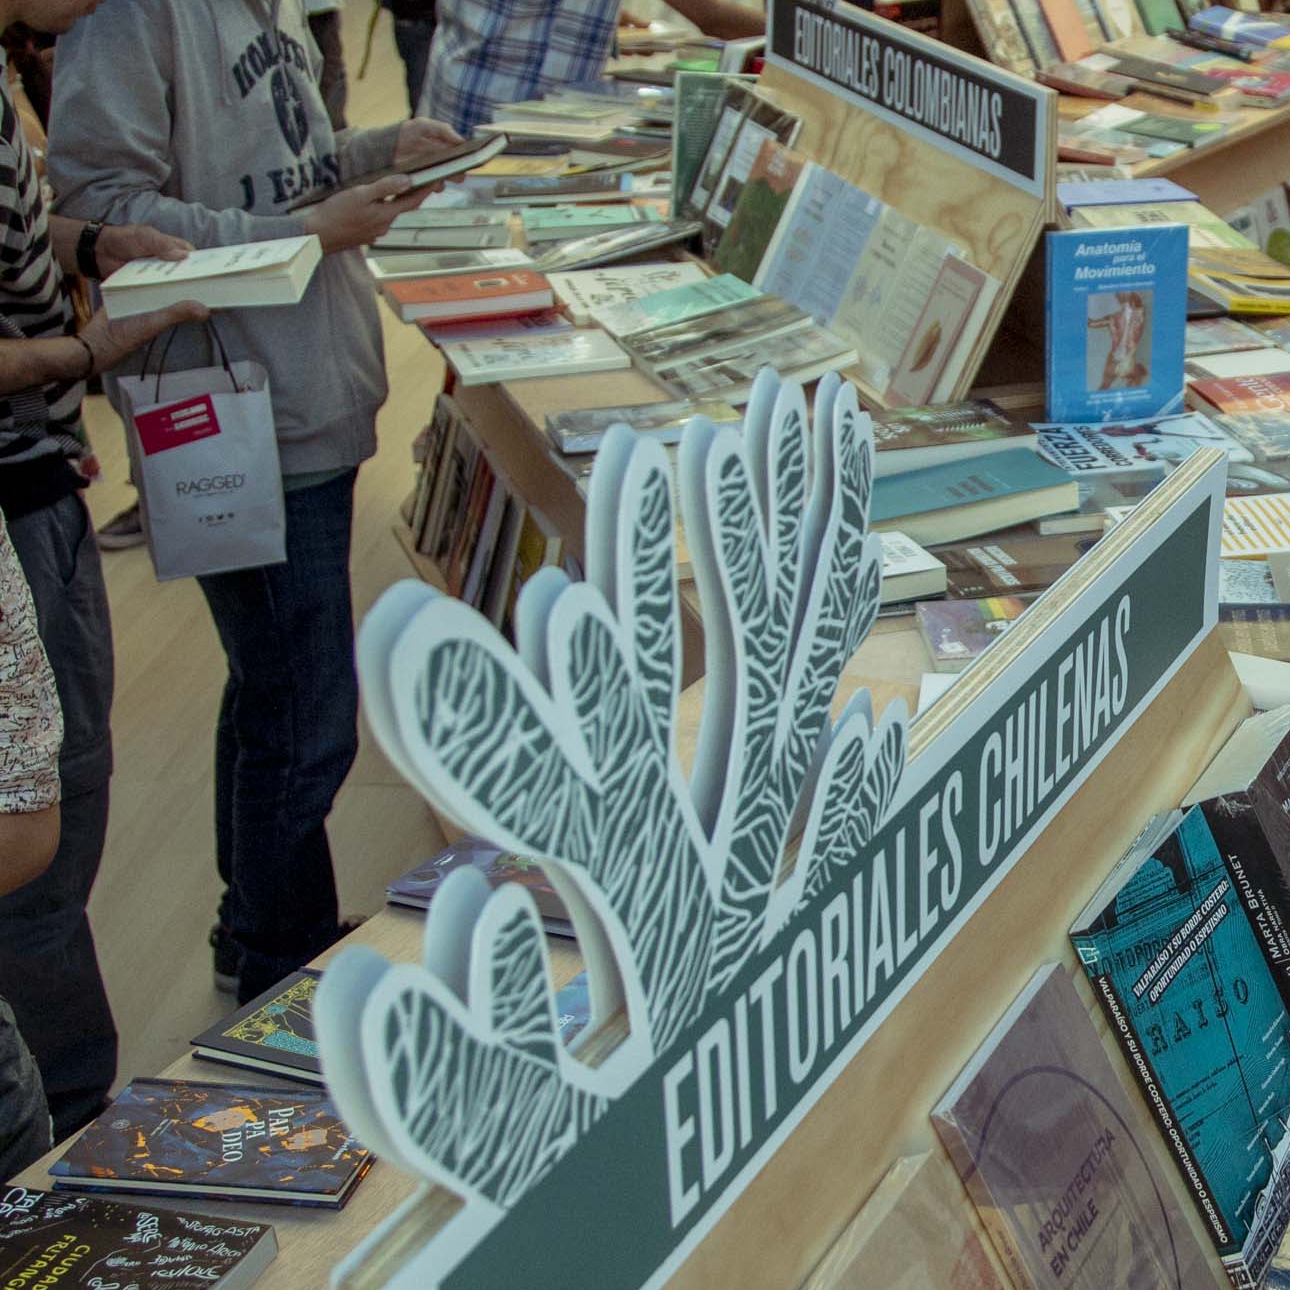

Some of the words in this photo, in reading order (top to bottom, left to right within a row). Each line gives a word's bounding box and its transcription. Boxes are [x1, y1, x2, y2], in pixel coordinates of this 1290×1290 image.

[794, 6, 879, 100] EDITORIALES
[883, 45, 1002, 159] COLOMBIANAS
[1073, 263, 1156, 280] Movimiento
[1043, 426, 1108, 471] FUERZA
[175, 474, 246, 496] RAGGED
[1227, 853, 1260, 910] BRUNET
[663, 780, 965, 1231] EDITORIALES
[977, 593, 1131, 867] CHILENAS
[1256, 888, 1280, 933] NARRATIVA
[1132, 952, 1167, 998] VALPARAÍSO
[1180, 910, 1203, 940] BORDE
[1200, 878, 1230, 916] COSTERO:
[1149, 946, 1191, 1003] OPORTUNIDAD
[1194, 903, 1229, 946] ESPEJISMO
[1255, 915, 1282, 959] MARTA
[1275, 932, 1290, 956] OBRA
[1098, 976, 1129, 1032] VALPARAÍSO
[1126, 1037, 1137, 1054] SU
[1132, 1051, 1152, 1084] BORDE
[1147, 1083, 1174, 1130] COSTERO:
[1168, 1127, 1204, 1191] OPORTUNIDAD
[245, 1120, 266, 1141] PA
[268, 1106, 295, 1138] PAR
[222, 1130, 243, 1163] DEO
[1036, 1127, 1116, 1253] ARQUITECTURA
[1049, 1242, 1071, 1279] EN
[1065, 1197, 1100, 1256] CHILE
